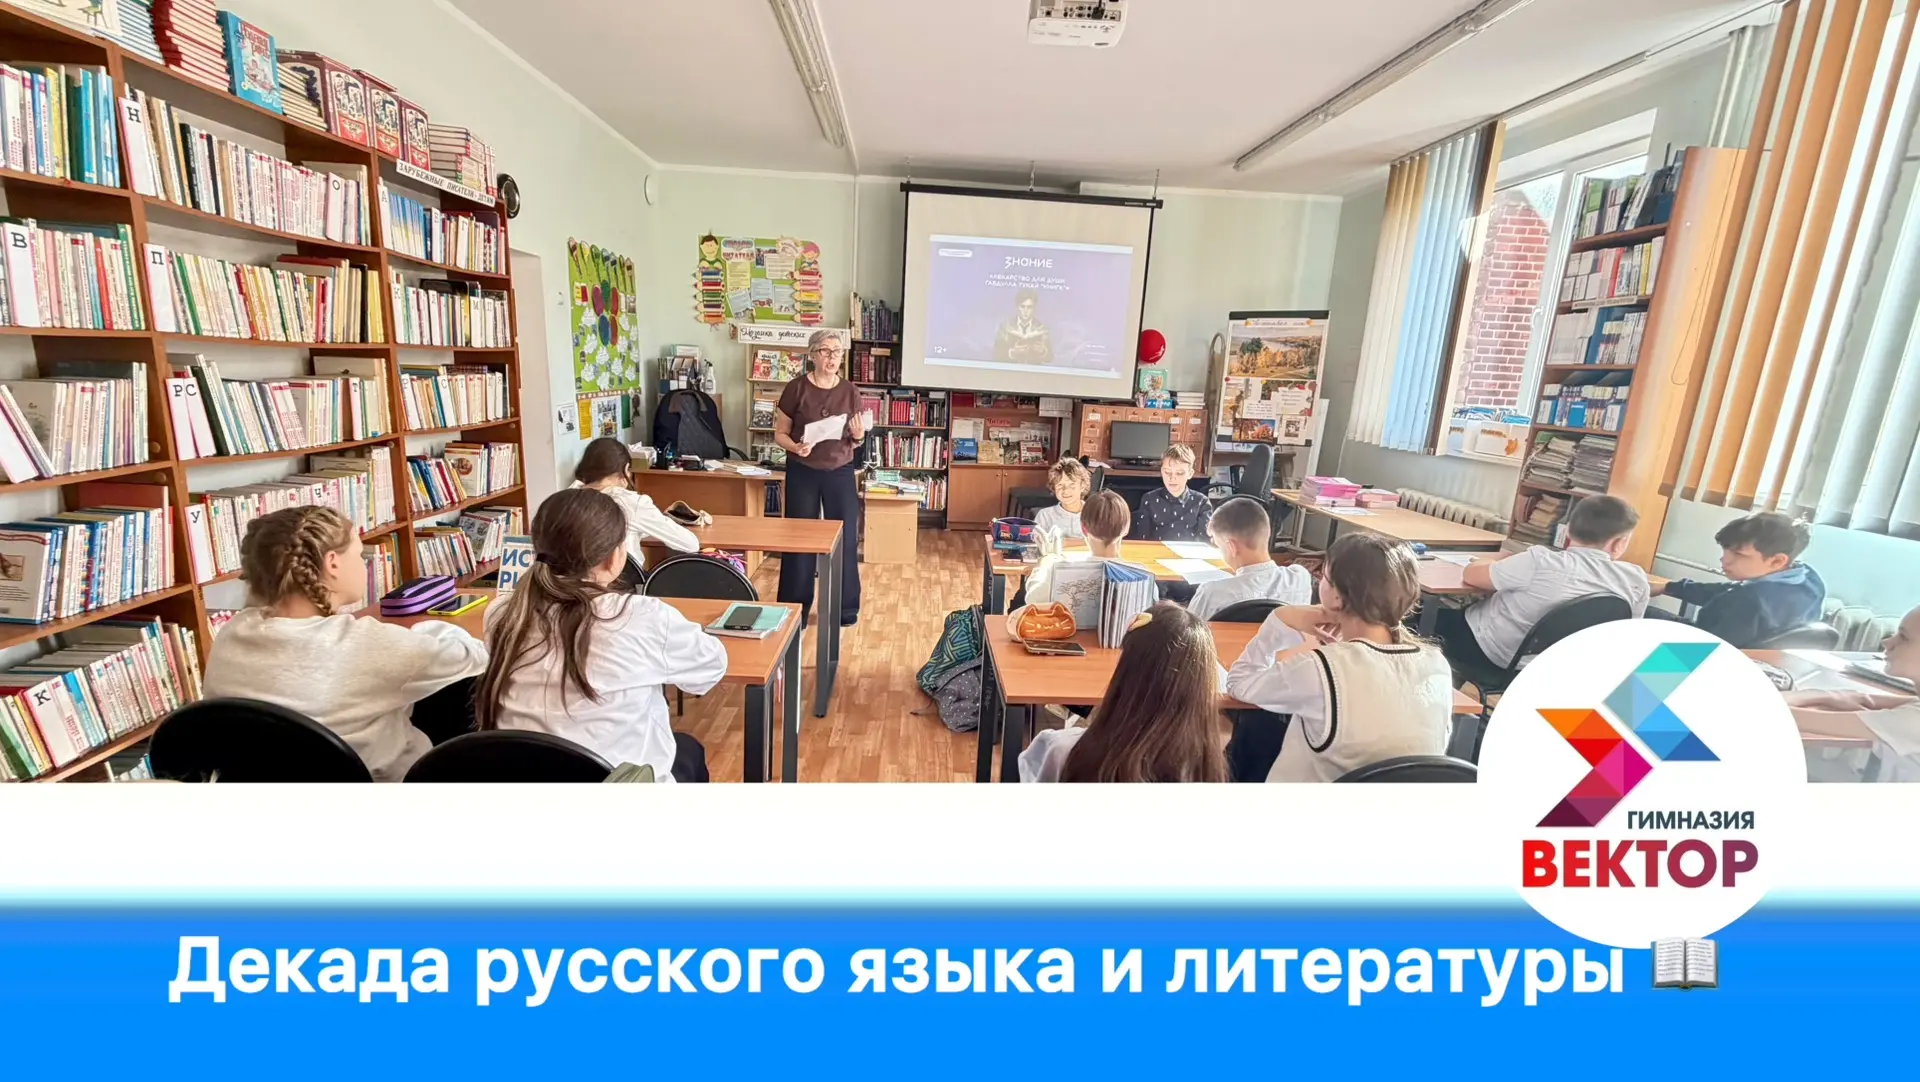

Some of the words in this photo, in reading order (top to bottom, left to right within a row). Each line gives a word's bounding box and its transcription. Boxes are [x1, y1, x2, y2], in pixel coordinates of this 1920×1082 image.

[126, 106, 141, 124] Н
[399, 162, 444, 188] ЗАРУБЕЖНЫЕ
[11, 232, 28, 249] В
[151, 251, 164, 266] П
[934, 346, 947, 354] 12+
[173, 384, 184, 398] Р
[186, 384, 197, 397] С
[502, 548, 534, 568] ИС
[33, 689, 51, 707] К
